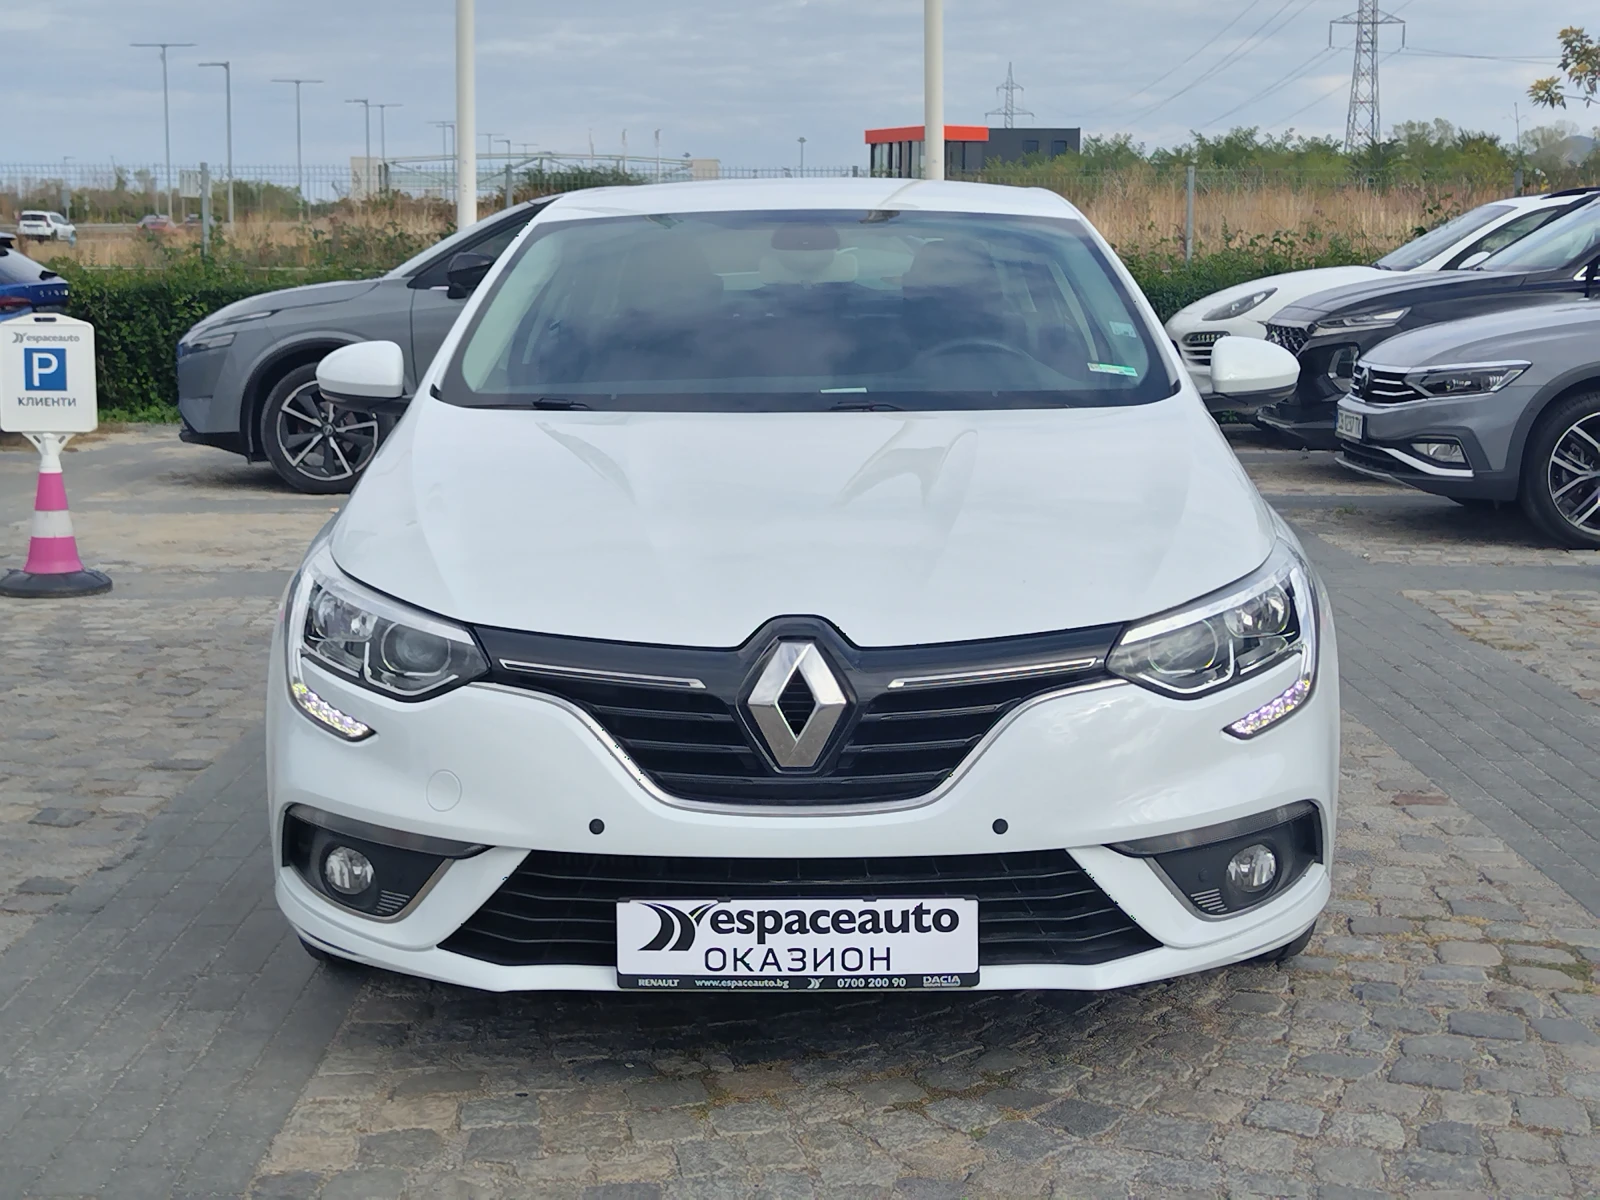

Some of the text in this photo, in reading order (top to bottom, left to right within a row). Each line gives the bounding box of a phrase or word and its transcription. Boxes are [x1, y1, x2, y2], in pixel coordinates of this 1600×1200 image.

[26, 334, 80, 343] espaceauto
[32, 352, 58, 387] P
[17, 397, 77, 407] КЛИЕНТИ
[709, 902, 960, 945] espaceauto
[704, 946, 891, 973] ОКАЗИОН
[638, 978, 680, 987] RENAULT
[694, 978, 790, 989] www.espaceauto.bg
[837, 977, 907, 988] 0700 200 90
[922, 975, 961, 984] DACIA
